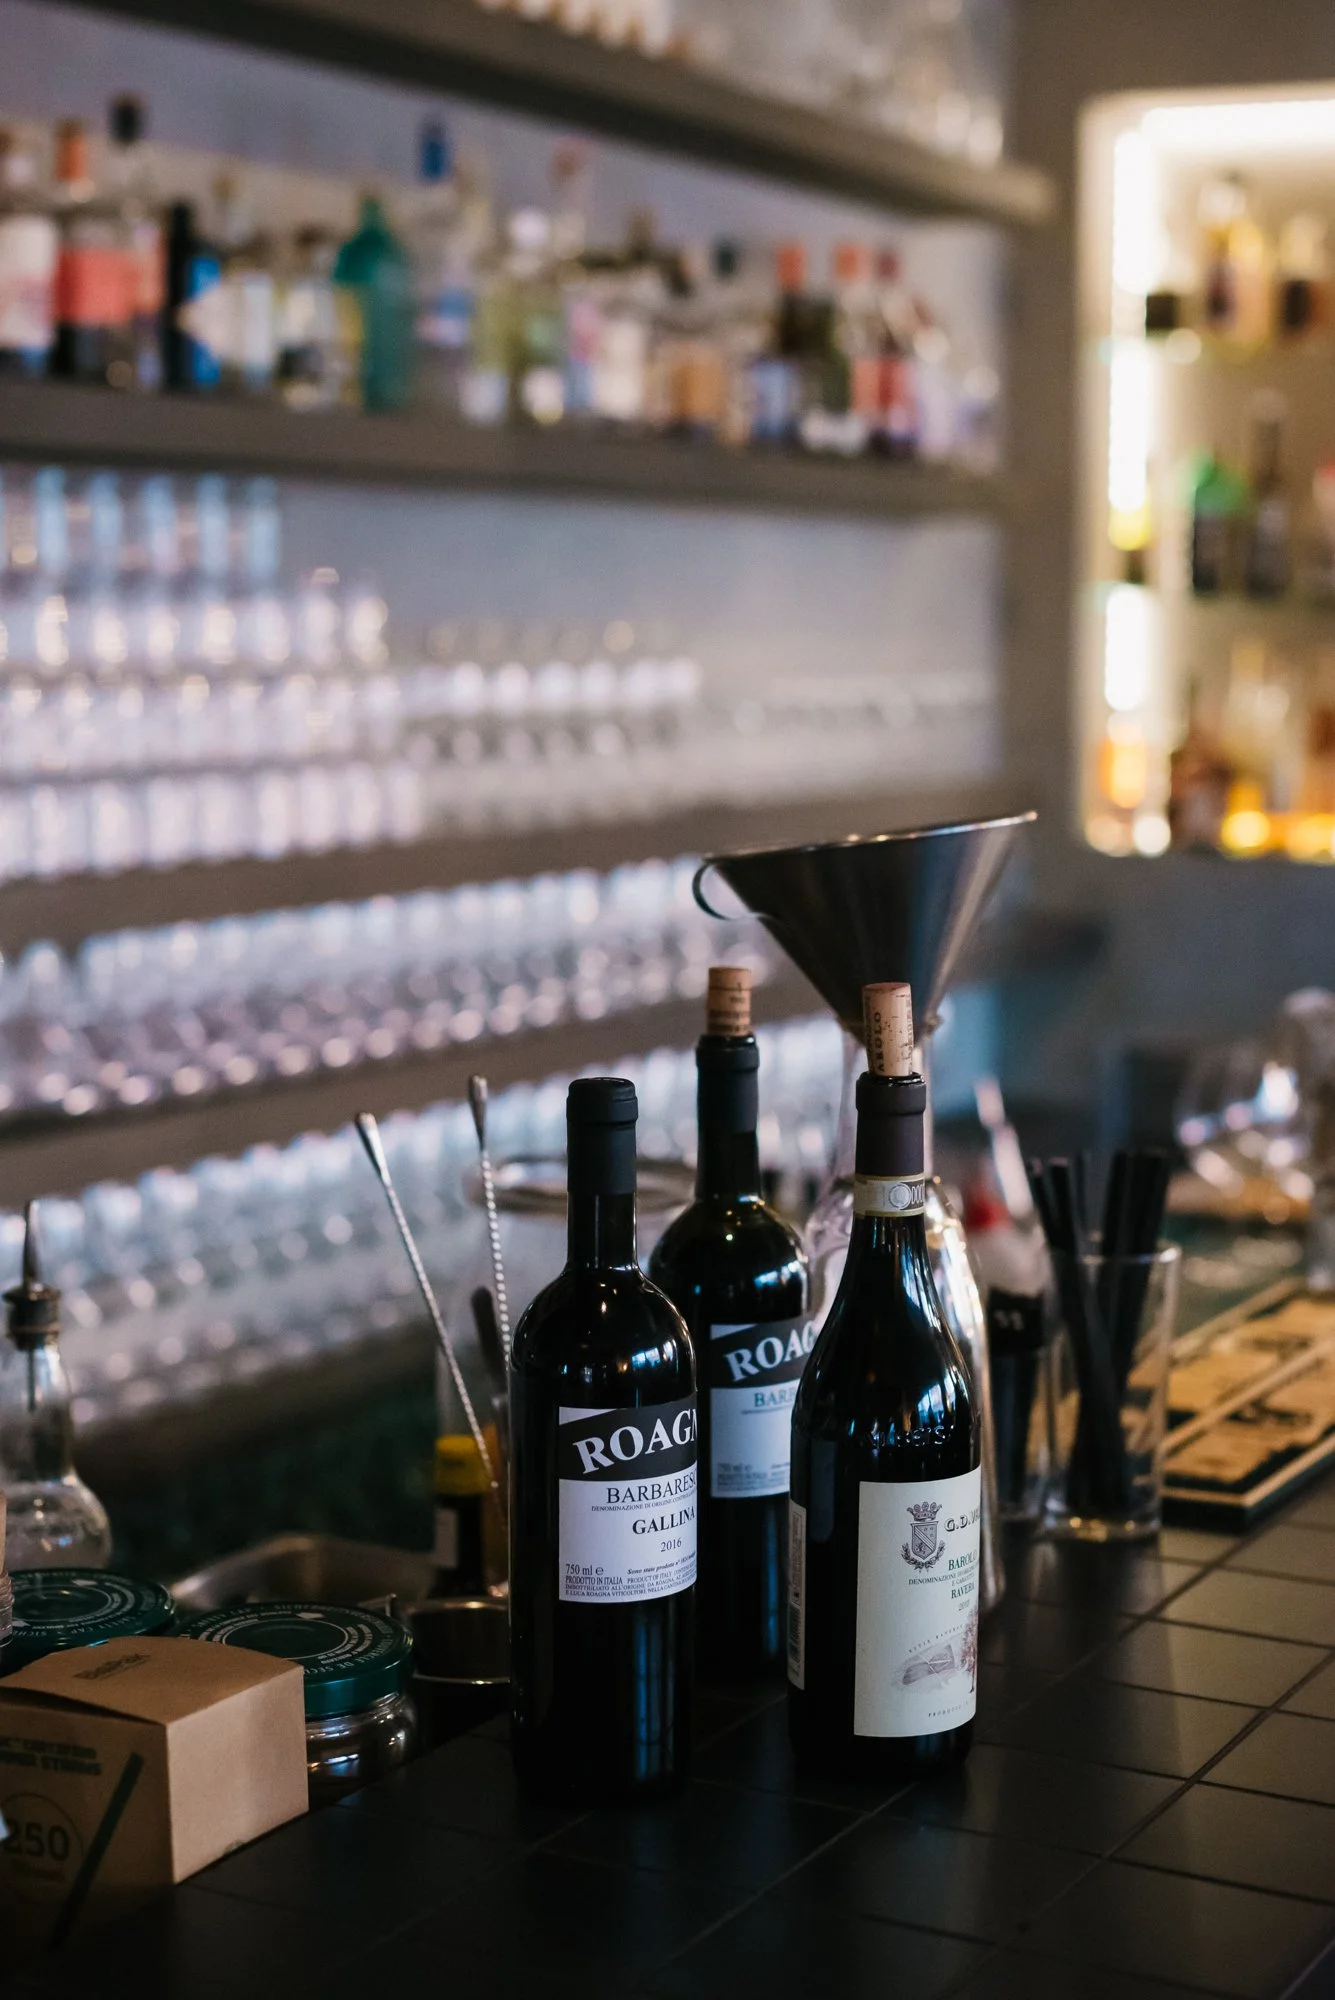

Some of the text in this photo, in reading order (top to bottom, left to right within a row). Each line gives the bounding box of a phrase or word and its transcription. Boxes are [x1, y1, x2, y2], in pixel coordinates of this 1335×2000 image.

[591, 1503, 644, 1512] DENOMINAZIONE
[632, 1506, 695, 1535] GALLINA
[661, 1538, 682, 1552] 2016
[566, 1563, 580, 1575] 750
[582, 1565, 593, 1575] ml
[565, 1576, 623, 1585] PRODOTTO IN ITALIA
[627, 1575, 652, 1583] PRODUCT
[660, 1571, 673, 1579] ITALY
[3, 1817, 70, 1861] 250
